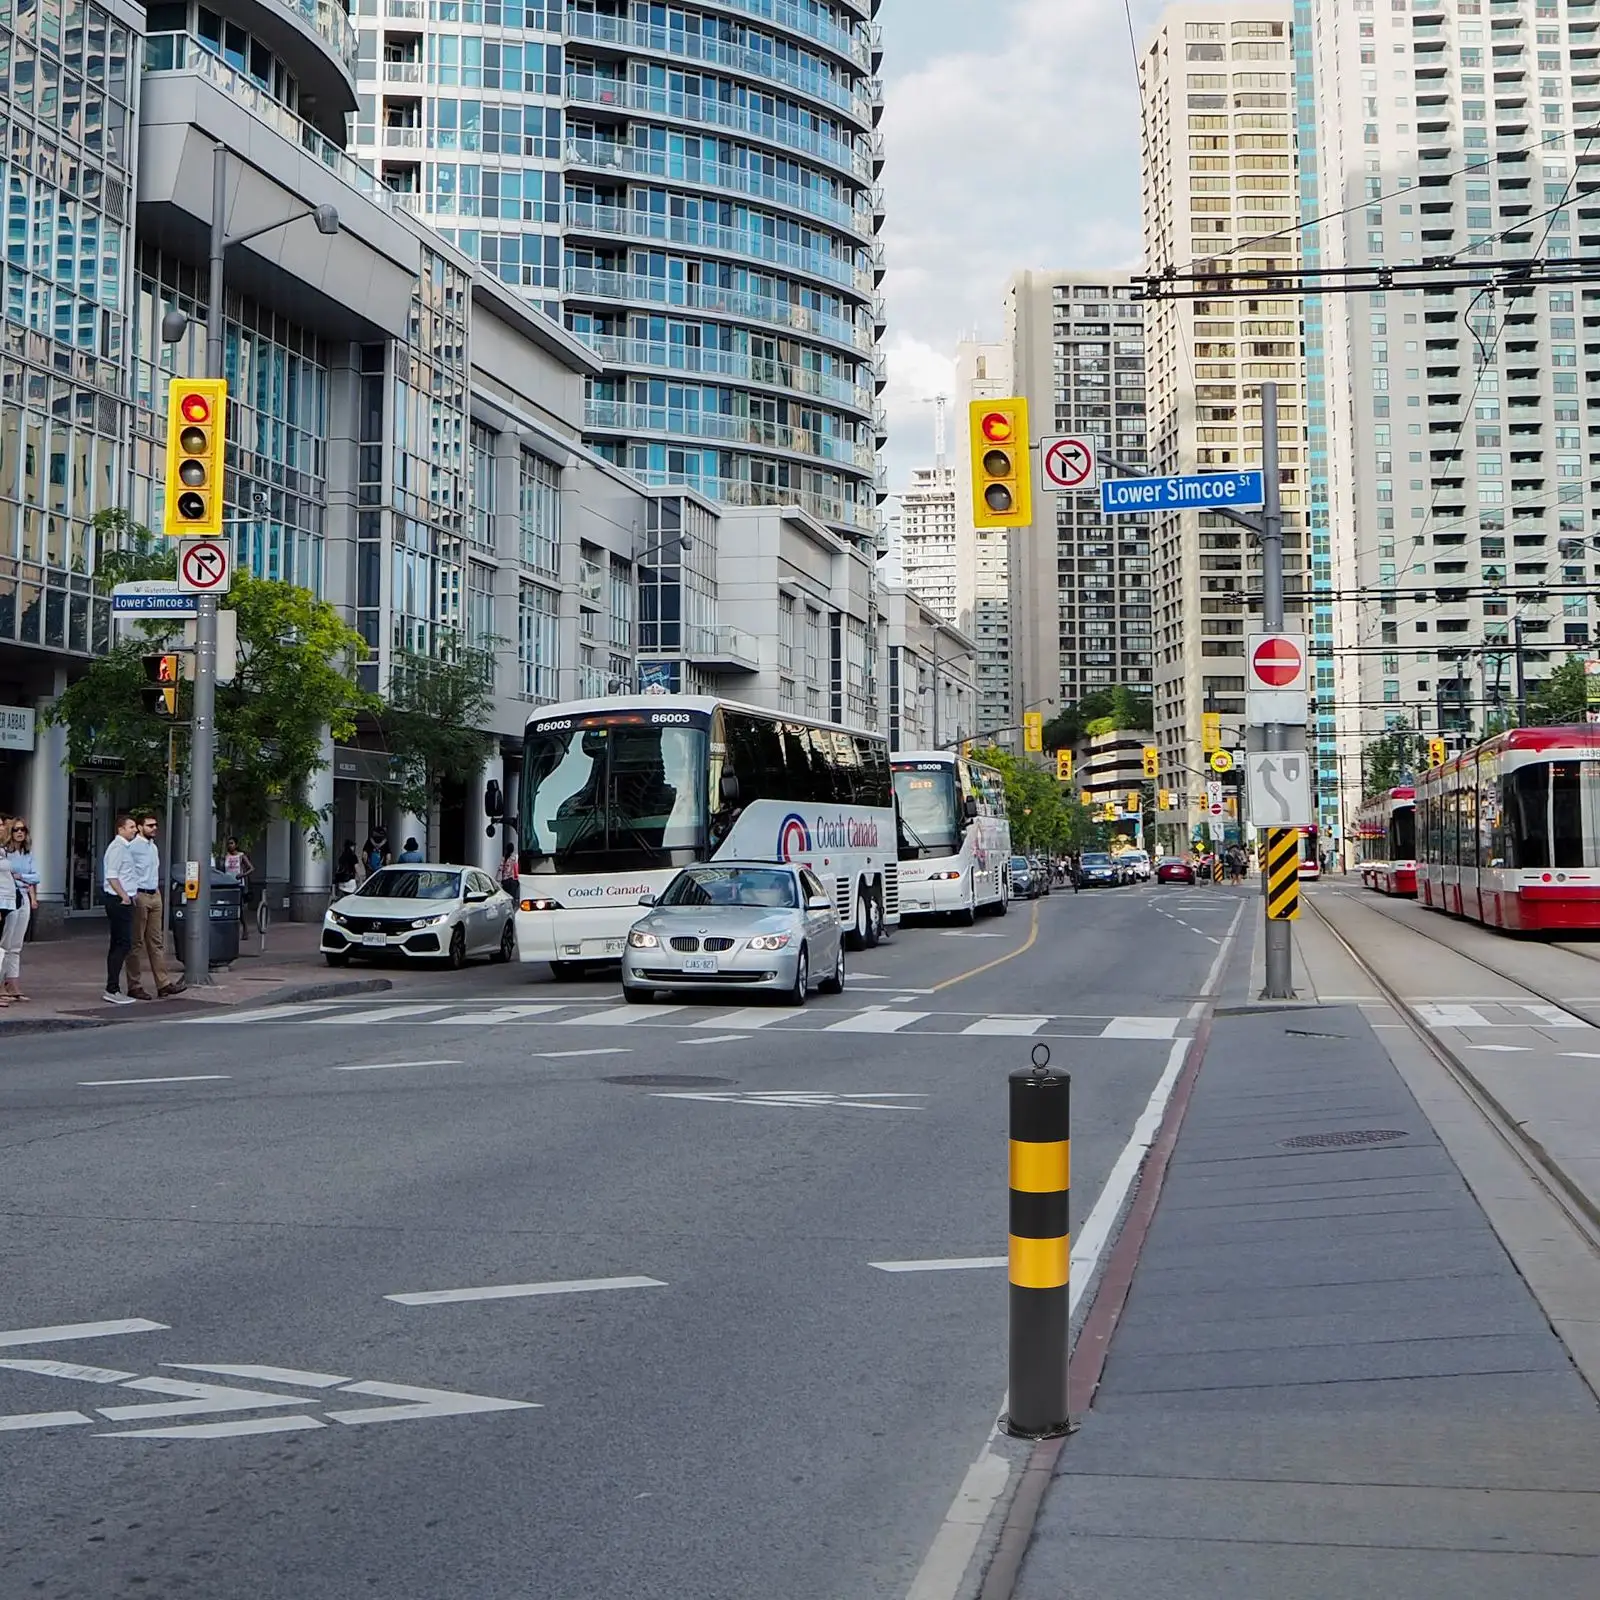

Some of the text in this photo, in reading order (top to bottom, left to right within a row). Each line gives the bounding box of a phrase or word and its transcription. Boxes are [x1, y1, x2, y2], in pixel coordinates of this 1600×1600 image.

[1108, 475, 1251, 505] Lower Simcoe St
[116, 597, 145, 608] Lower
[147, 597, 183, 608] Simcoe
[651, 713, 690, 725] 86003
[536, 720, 572, 732] 86003
[816, 813, 878, 849] Coach Canada
[568, 885, 650, 897] Coach Canada
